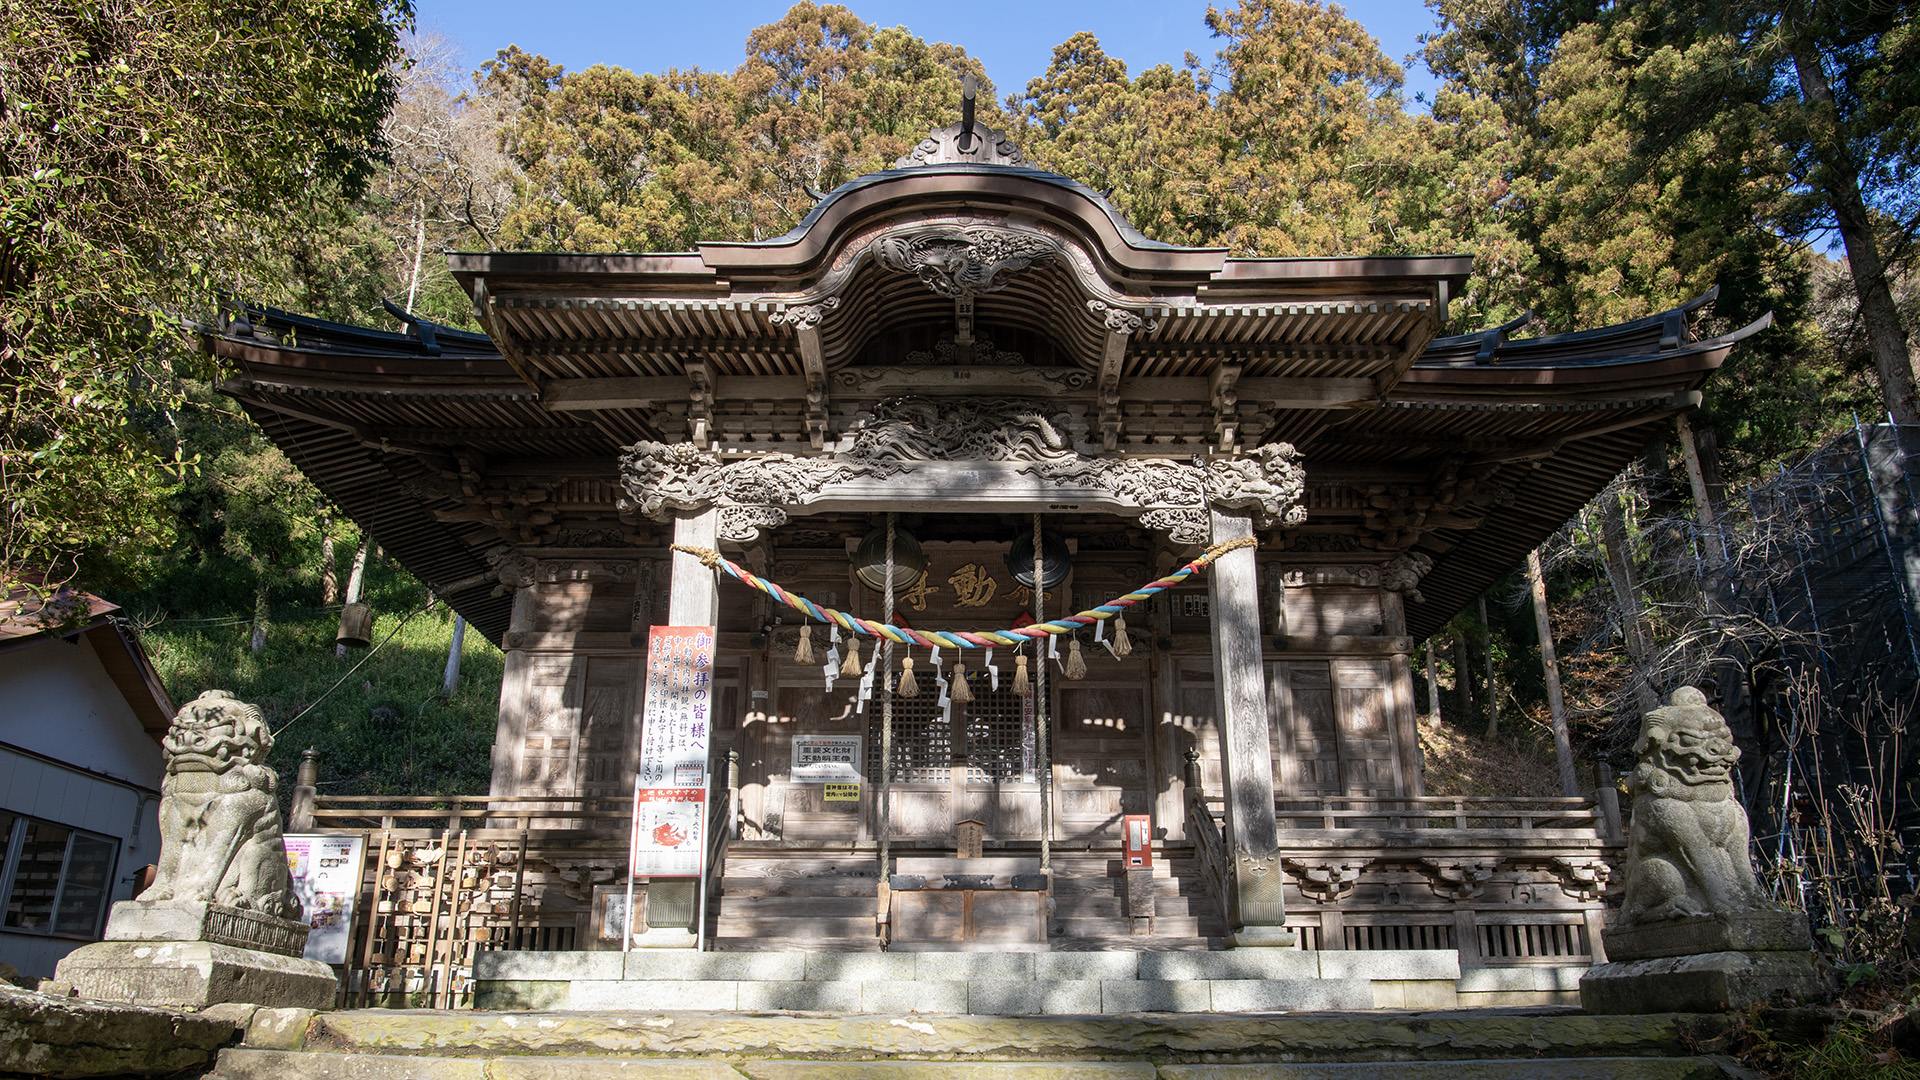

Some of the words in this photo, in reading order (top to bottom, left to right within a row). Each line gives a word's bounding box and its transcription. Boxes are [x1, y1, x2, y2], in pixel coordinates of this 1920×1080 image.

[690, 632, 712, 750] 御参拝の皆様へ
